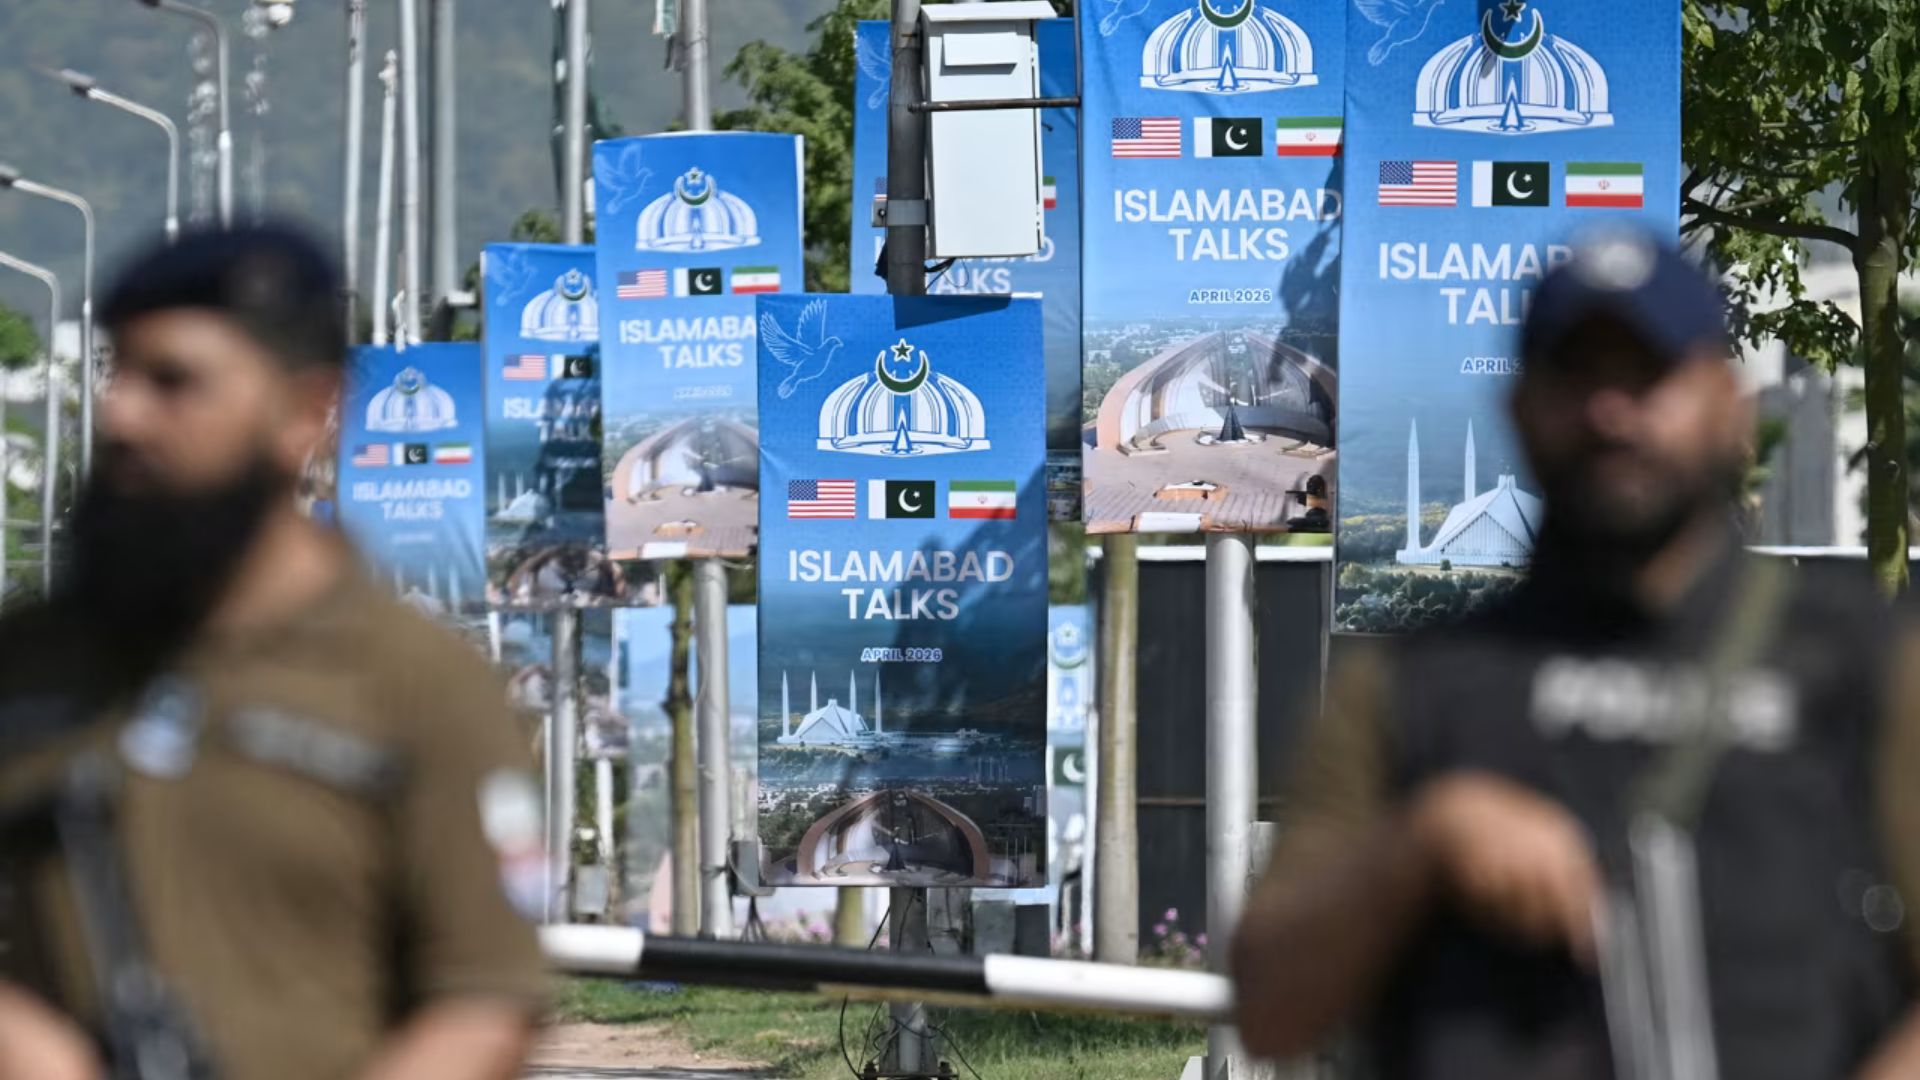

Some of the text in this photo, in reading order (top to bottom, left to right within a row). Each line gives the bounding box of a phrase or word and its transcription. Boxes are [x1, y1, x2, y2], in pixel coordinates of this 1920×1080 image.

[1114, 188, 1342, 222] ISLAMABAD
[1168, 228, 1290, 261] TALKS
[1378, 242, 1574, 280] ISLAMA
[926, 268, 1011, 292] ALKS
[1188, 289, 1272, 304] APRIL 2026
[1439, 287, 1530, 326] TAL
[619, 316, 757, 344] ISLAMABA
[658, 344, 744, 369] TALKS
[1460, 357, 1511, 375] APRIL
[788, 550, 1015, 583] ISLAMABAD
[841, 588, 960, 620] TALKS
[860, 647, 942, 663] APRIL 2026
